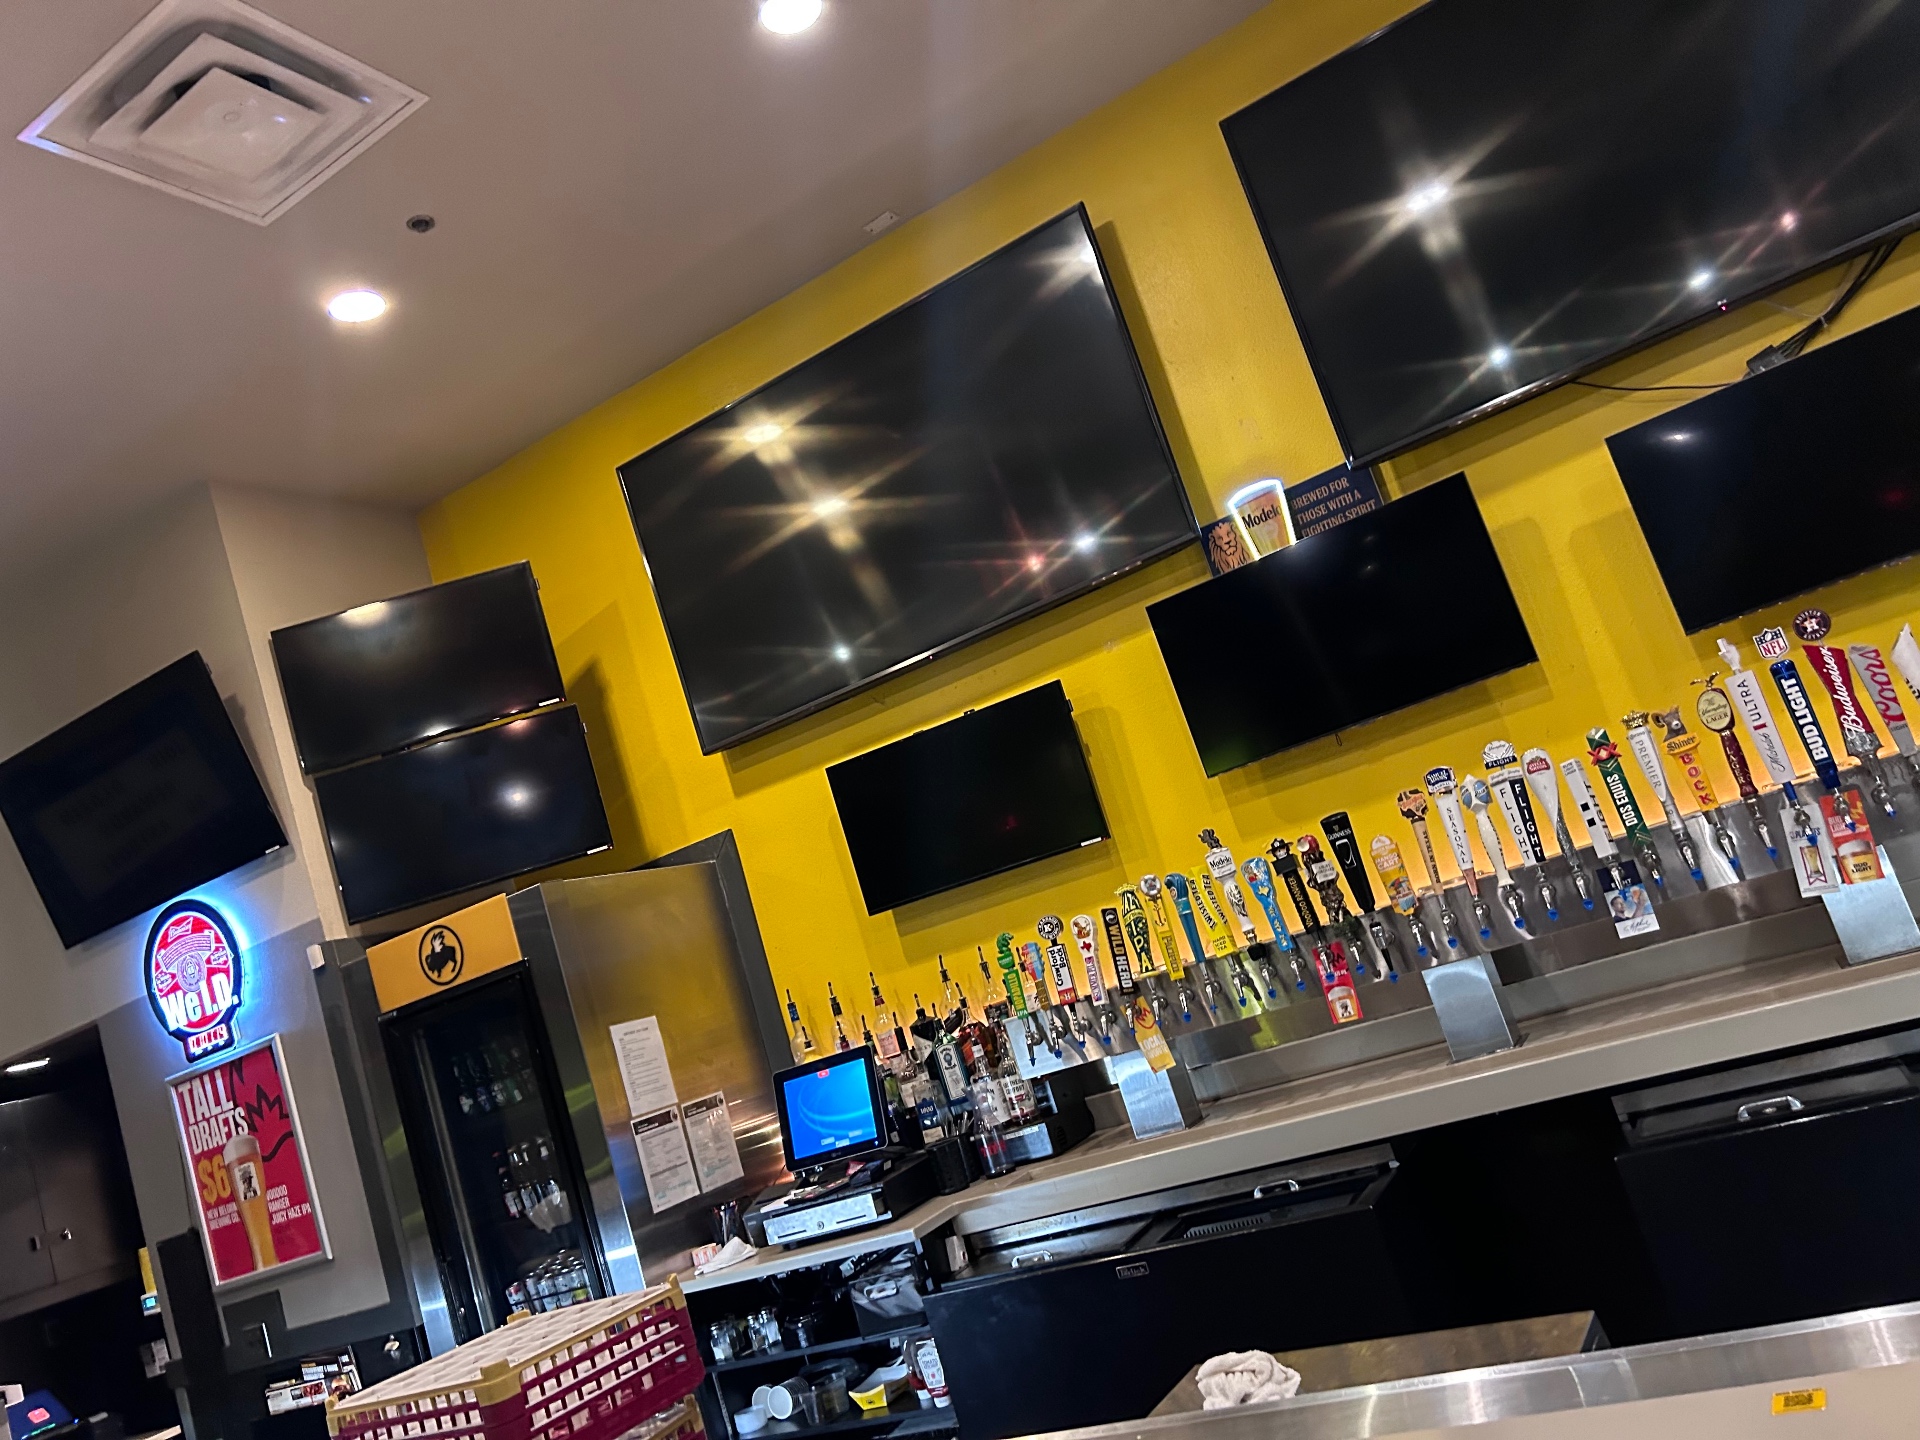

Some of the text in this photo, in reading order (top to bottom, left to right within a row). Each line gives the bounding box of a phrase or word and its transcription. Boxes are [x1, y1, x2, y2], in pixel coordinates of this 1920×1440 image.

[1292, 477, 1350, 509] BREWED FOR
[1297, 489, 1362, 525] THOSE WITH A
[1242, 504, 1282, 529] Modelo
[1302, 499, 1376, 538] FIGHTING SPIRIT
[1761, 641, 1785, 656] NFL
[1737, 678, 1762, 723] ULTRA
[1820, 645, 1865, 739] Budweiser
[1705, 712, 1729, 724] LAGER
[1780, 678, 1829, 761] BUD LIGHT
[1488, 756, 1514, 768] FLIGHT
[1666, 736, 1696, 752] Shiner
[1635, 740, 1662, 789] PREMIER
[1679, 753, 1713, 805] BOCK
[1606, 774, 1638, 827] DOS EQUIS
[1327, 828, 1352, 840] GUINNESS
[1446, 807, 1469, 864] SEASONAL
[1499, 788, 1530, 861] FLIGHT
[1515, 783, 1541, 857] FLIGHT
[1209, 856, 1232, 869] Modelo
[1378, 857, 1399, 870] CART
[1189, 879, 1216, 929] TWISTED TEA
[1202, 874, 1228, 925] TWISTED TEA
[1288, 875, 1314, 928] VOODOO RANGER
[1056, 947, 1067, 969] Bock
[1109, 924, 1125, 955] WILD
[1131, 919, 1153, 973] IPA
[1212, 936, 1226, 944] HARD
[1049, 949, 1064, 987] Crawford
[1116, 956, 1133, 988] HERD
[1007, 973, 1025, 1010] HOPADILLO
[159, 990, 202, 1032] We
[1017, 1009, 1028, 1017] IPA
[1138, 1034, 1166, 1052] LOCAL
[178, 1068, 234, 1125] TALL
[188, 1107, 249, 1155] DRAFTS
[198, 1153, 232, 1205] $6
[268, 1196, 290, 1213] RANGER
[272, 1202, 312, 1225] JUICY HAZE IPA
